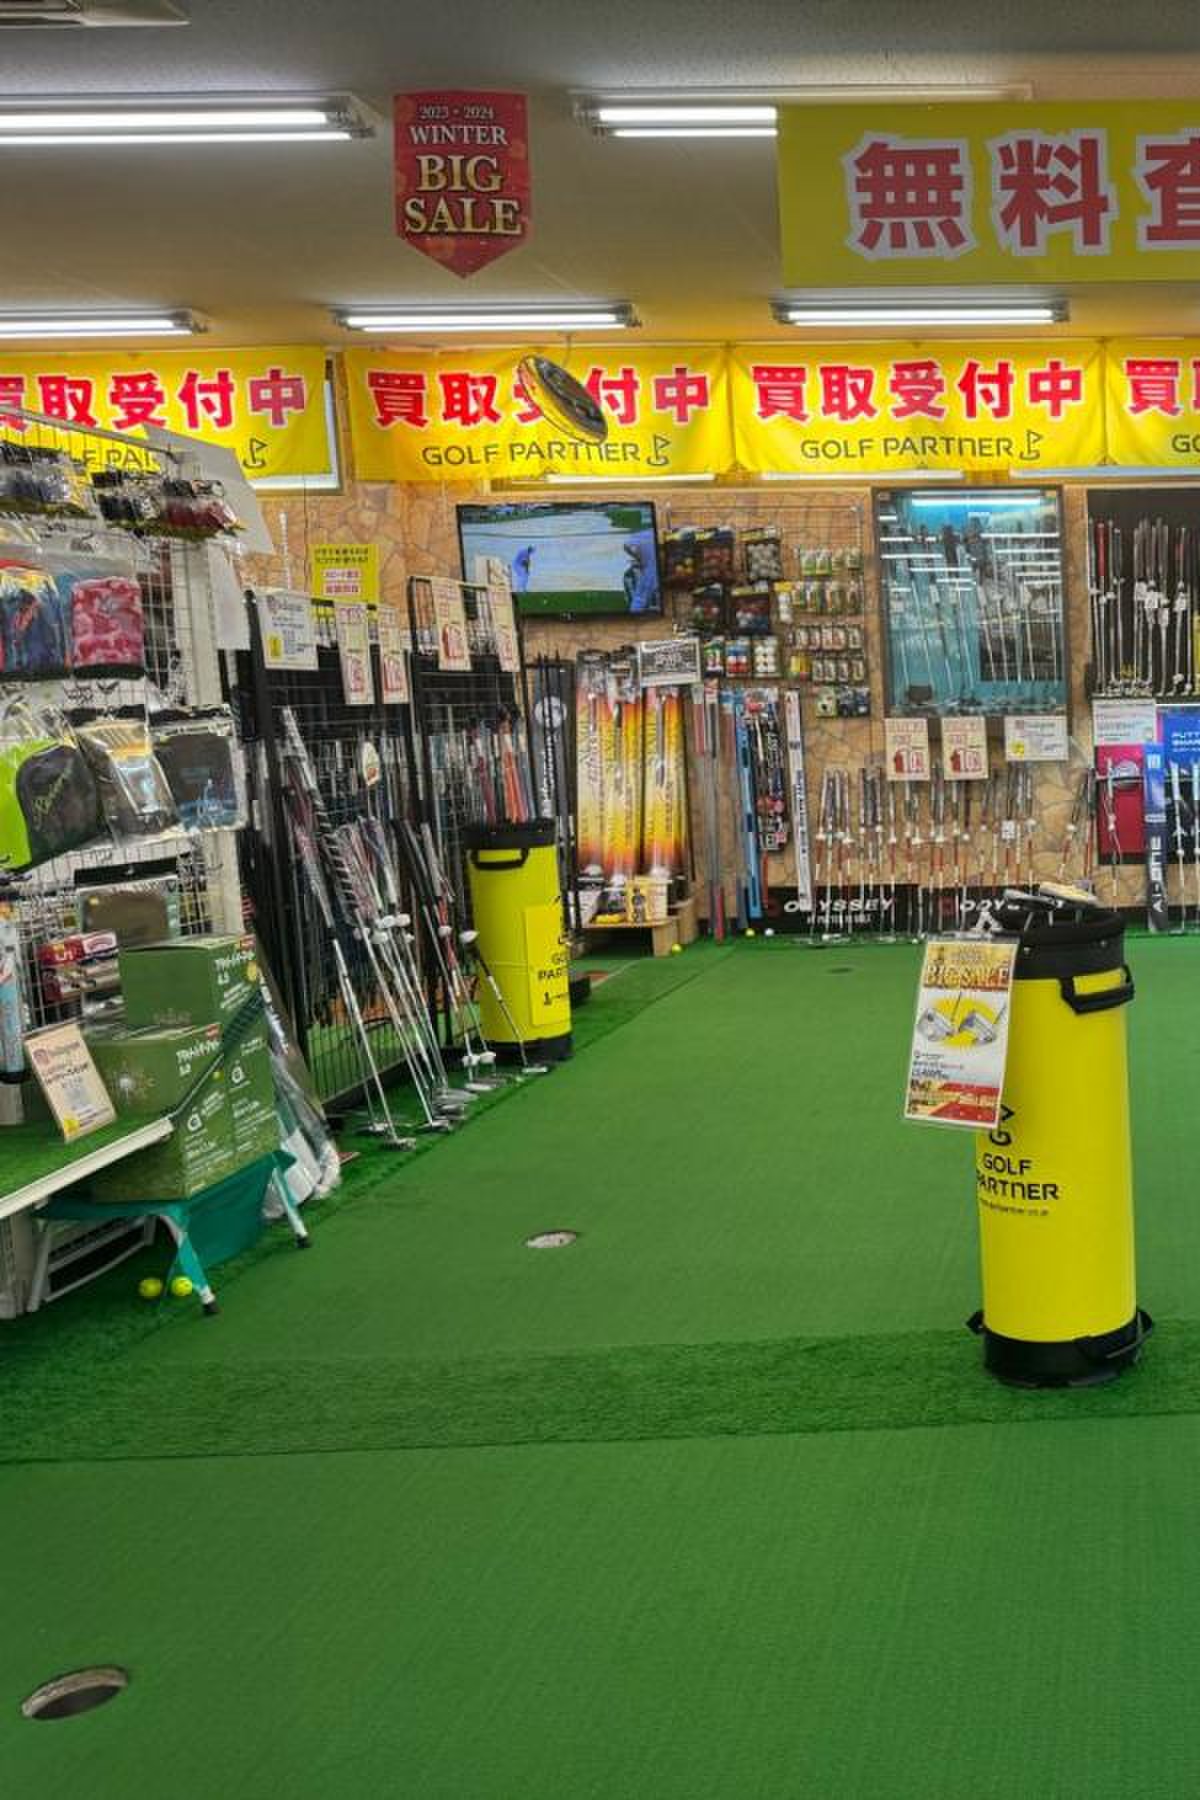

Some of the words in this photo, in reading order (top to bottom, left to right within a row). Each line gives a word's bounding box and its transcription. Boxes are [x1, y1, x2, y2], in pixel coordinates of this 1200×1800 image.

[409, 125, 508, 146] WINTER
[415, 154, 504, 193] BIG
[404, 197, 523, 236] SALE
[751, 358, 1084, 422] 買取受付中
[422, 443, 499, 466] GOLF
[509, 440, 642, 463] PARTNER
[800, 437, 873, 460] GOLF
[883, 434, 1014, 459] PARTNER
[783, 899, 894, 913] OYSSEY
[983, 1152, 1033, 1175] GOLF
